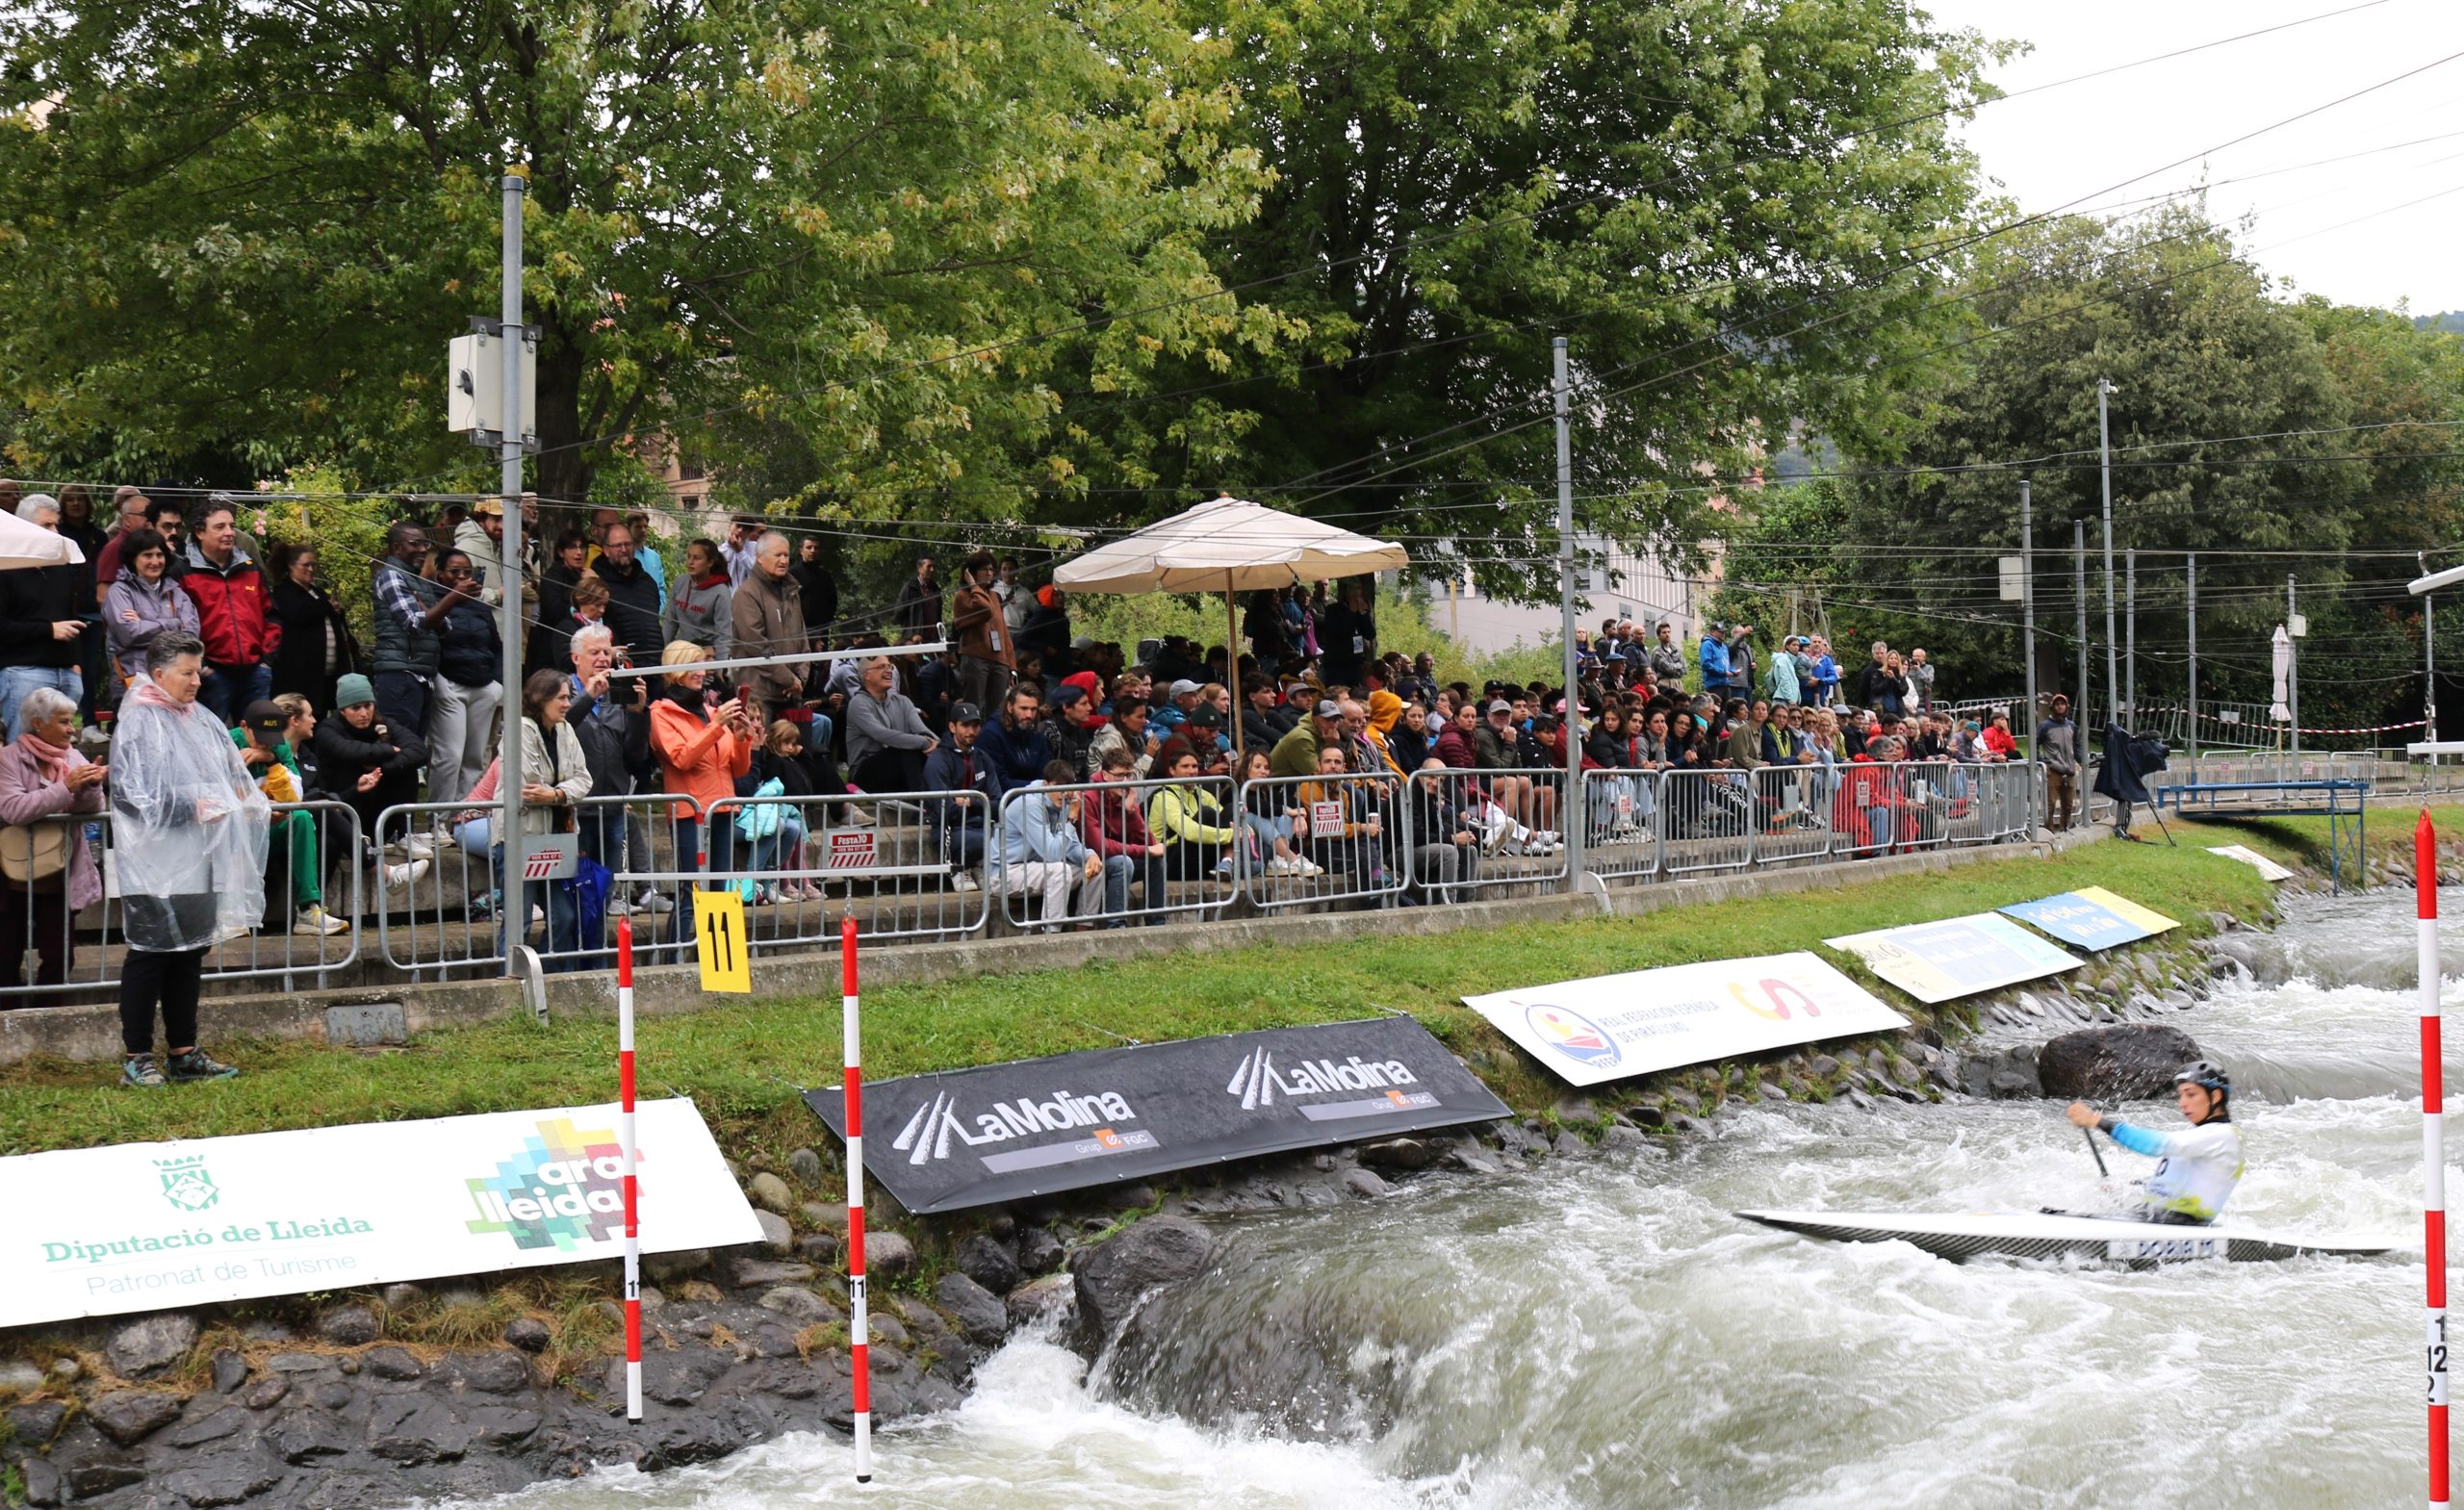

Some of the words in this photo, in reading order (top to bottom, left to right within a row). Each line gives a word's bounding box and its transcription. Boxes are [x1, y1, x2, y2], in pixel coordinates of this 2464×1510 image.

[707, 911, 732, 972] 11
[1598, 1016, 1628, 1029] REAL
[1263, 1056, 1418, 1095] LaMolina
[941, 1089, 1137, 1146] LaMolina
[1411, 1095, 1431, 1105] FGC
[1075, 1142, 1101, 1153] Grup
[1123, 1134, 1148, 1145] FGC
[537, 1156, 625, 1186] ara
[474, 1182, 626, 1223] lleida
[41, 1228, 214, 1264] Diputació
[221, 1224, 261, 1243] de
[266, 1216, 374, 1241] Lleida
[86, 1263, 205, 1295] Patronat
[215, 1261, 248, 1281] de
[252, 1255, 357, 1279] Turisme
[850, 1279, 864, 1298] 11
